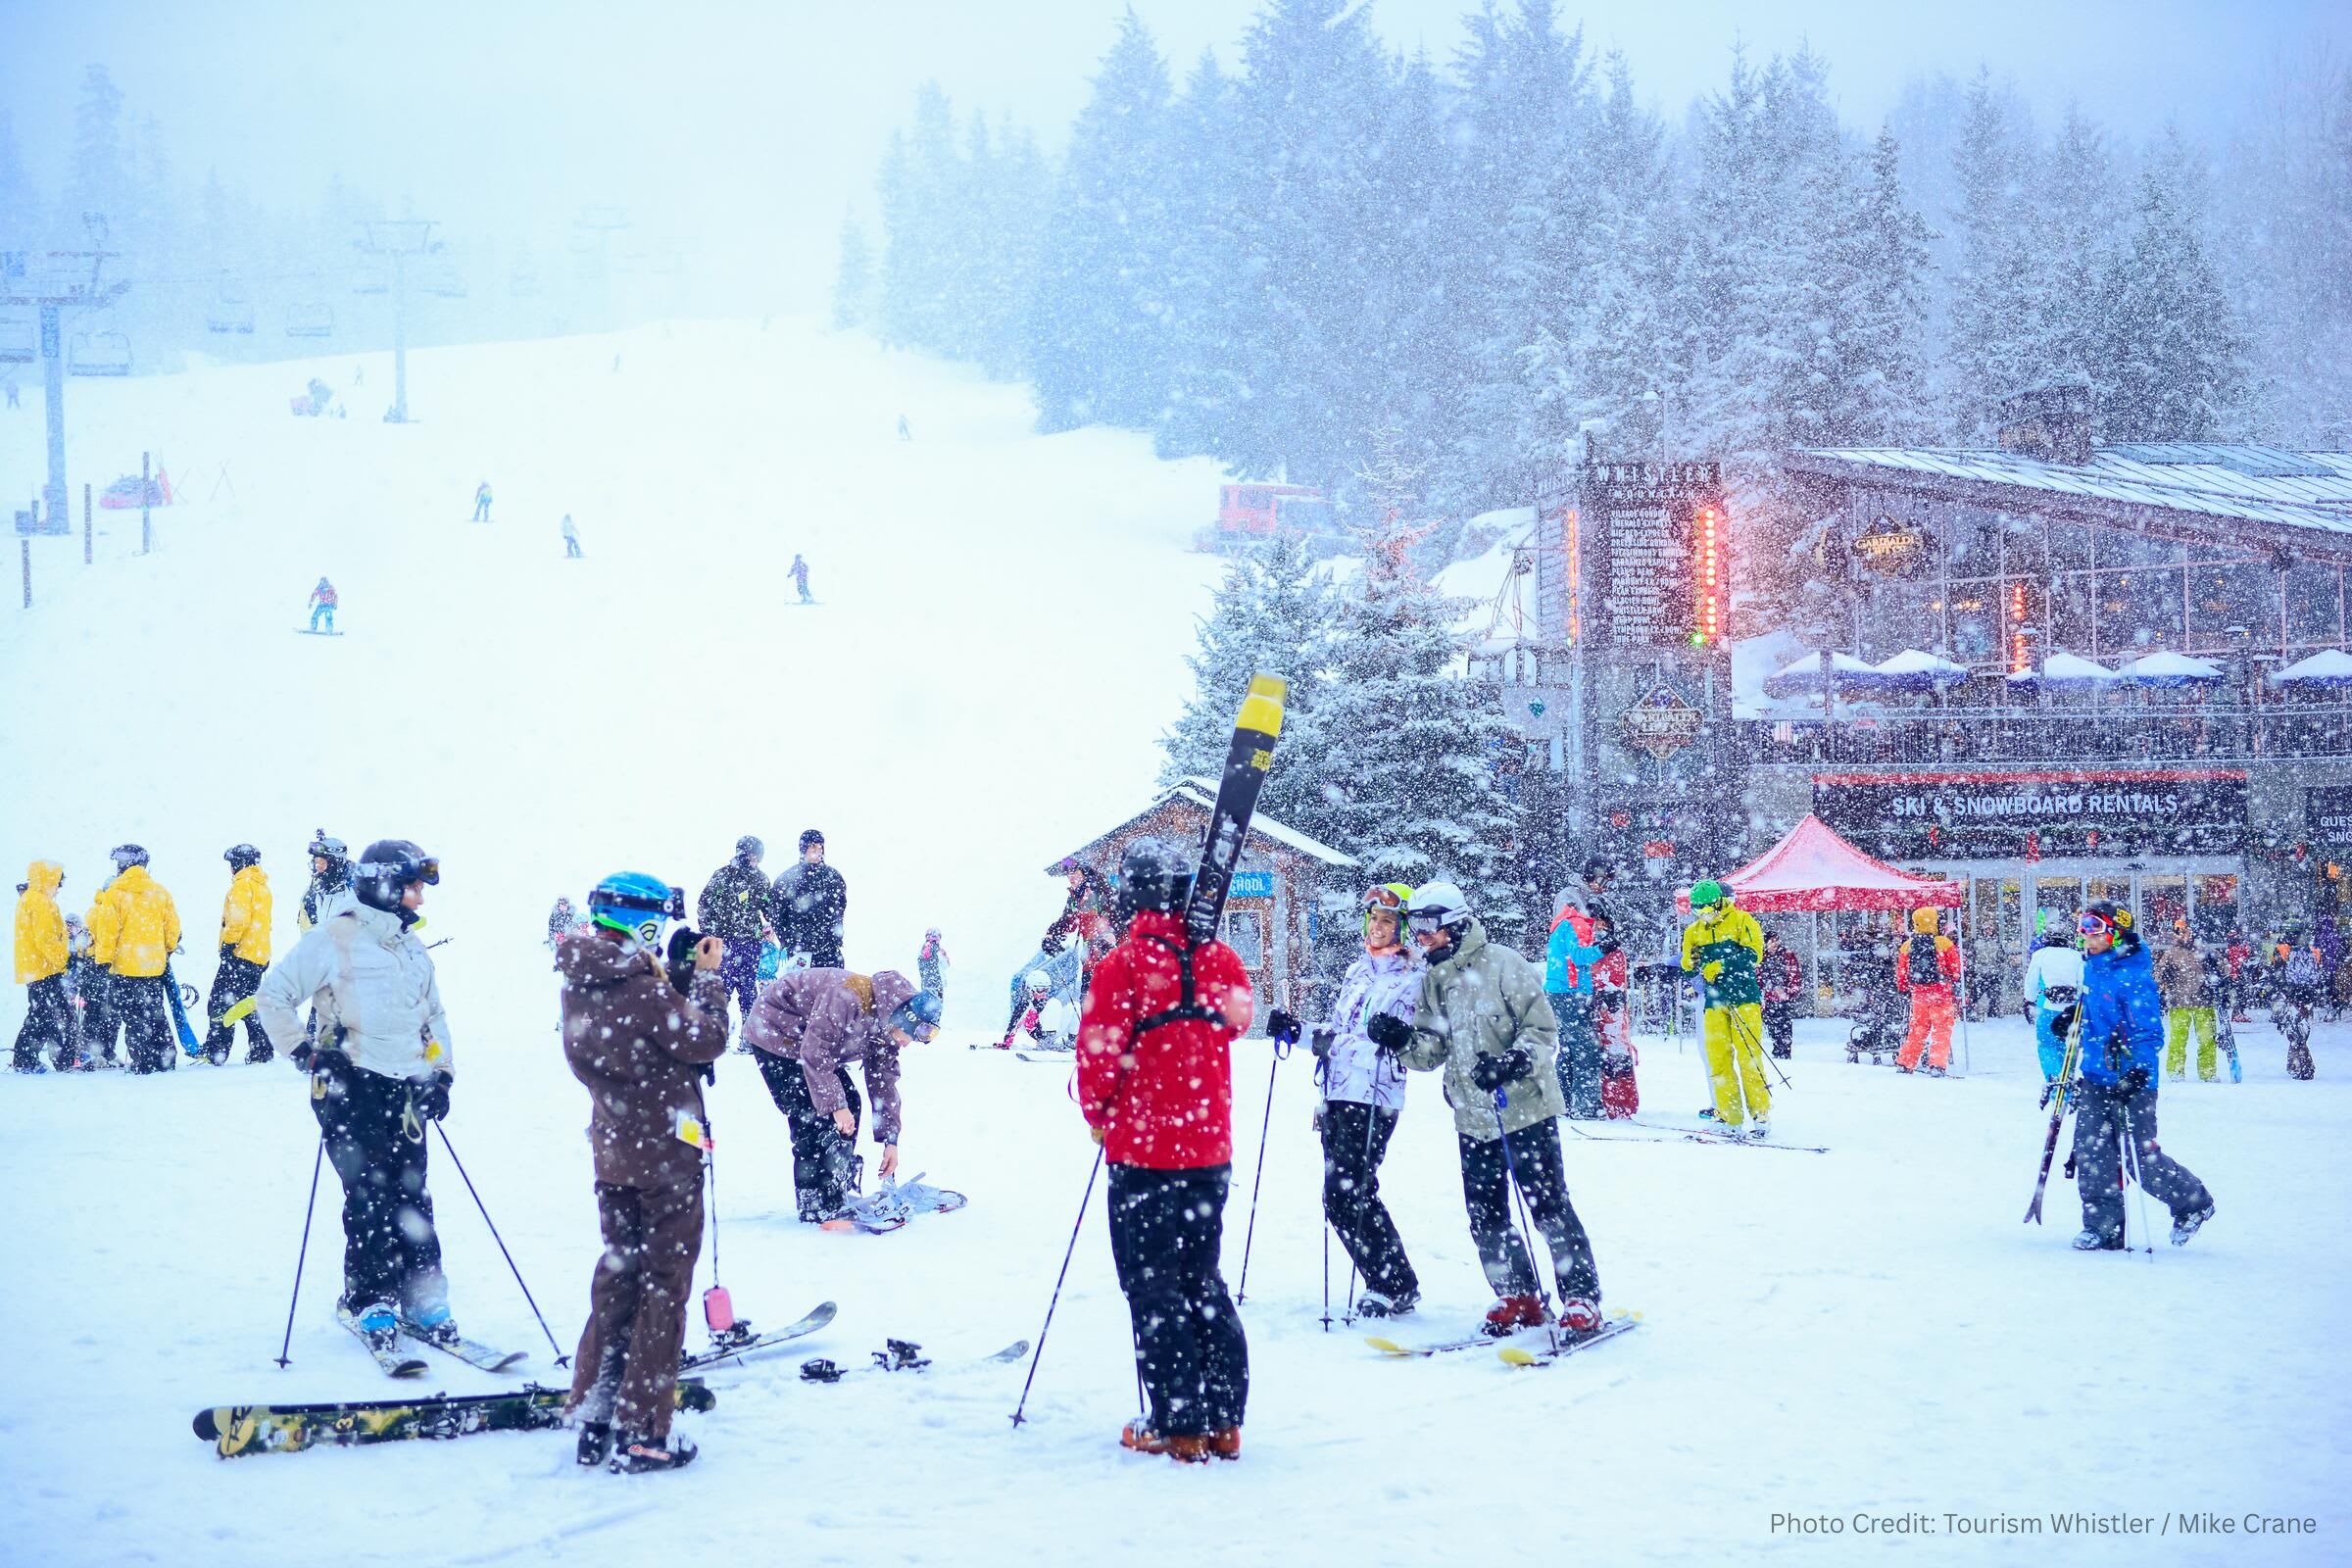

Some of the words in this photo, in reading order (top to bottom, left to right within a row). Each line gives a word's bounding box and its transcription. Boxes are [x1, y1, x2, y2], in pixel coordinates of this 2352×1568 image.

[1597, 465, 1709, 482] WHISTLER
[1614, 489, 1695, 500] MOUNTAIN
[1892, 798, 1926, 816] SKI
[1933, 800, 1946, 815] &
[1955, 797, 2082, 815] SNOWBOARD
[2089, 794, 2179, 813] RENTALS
[1231, 878, 1265, 894] CHOOL
